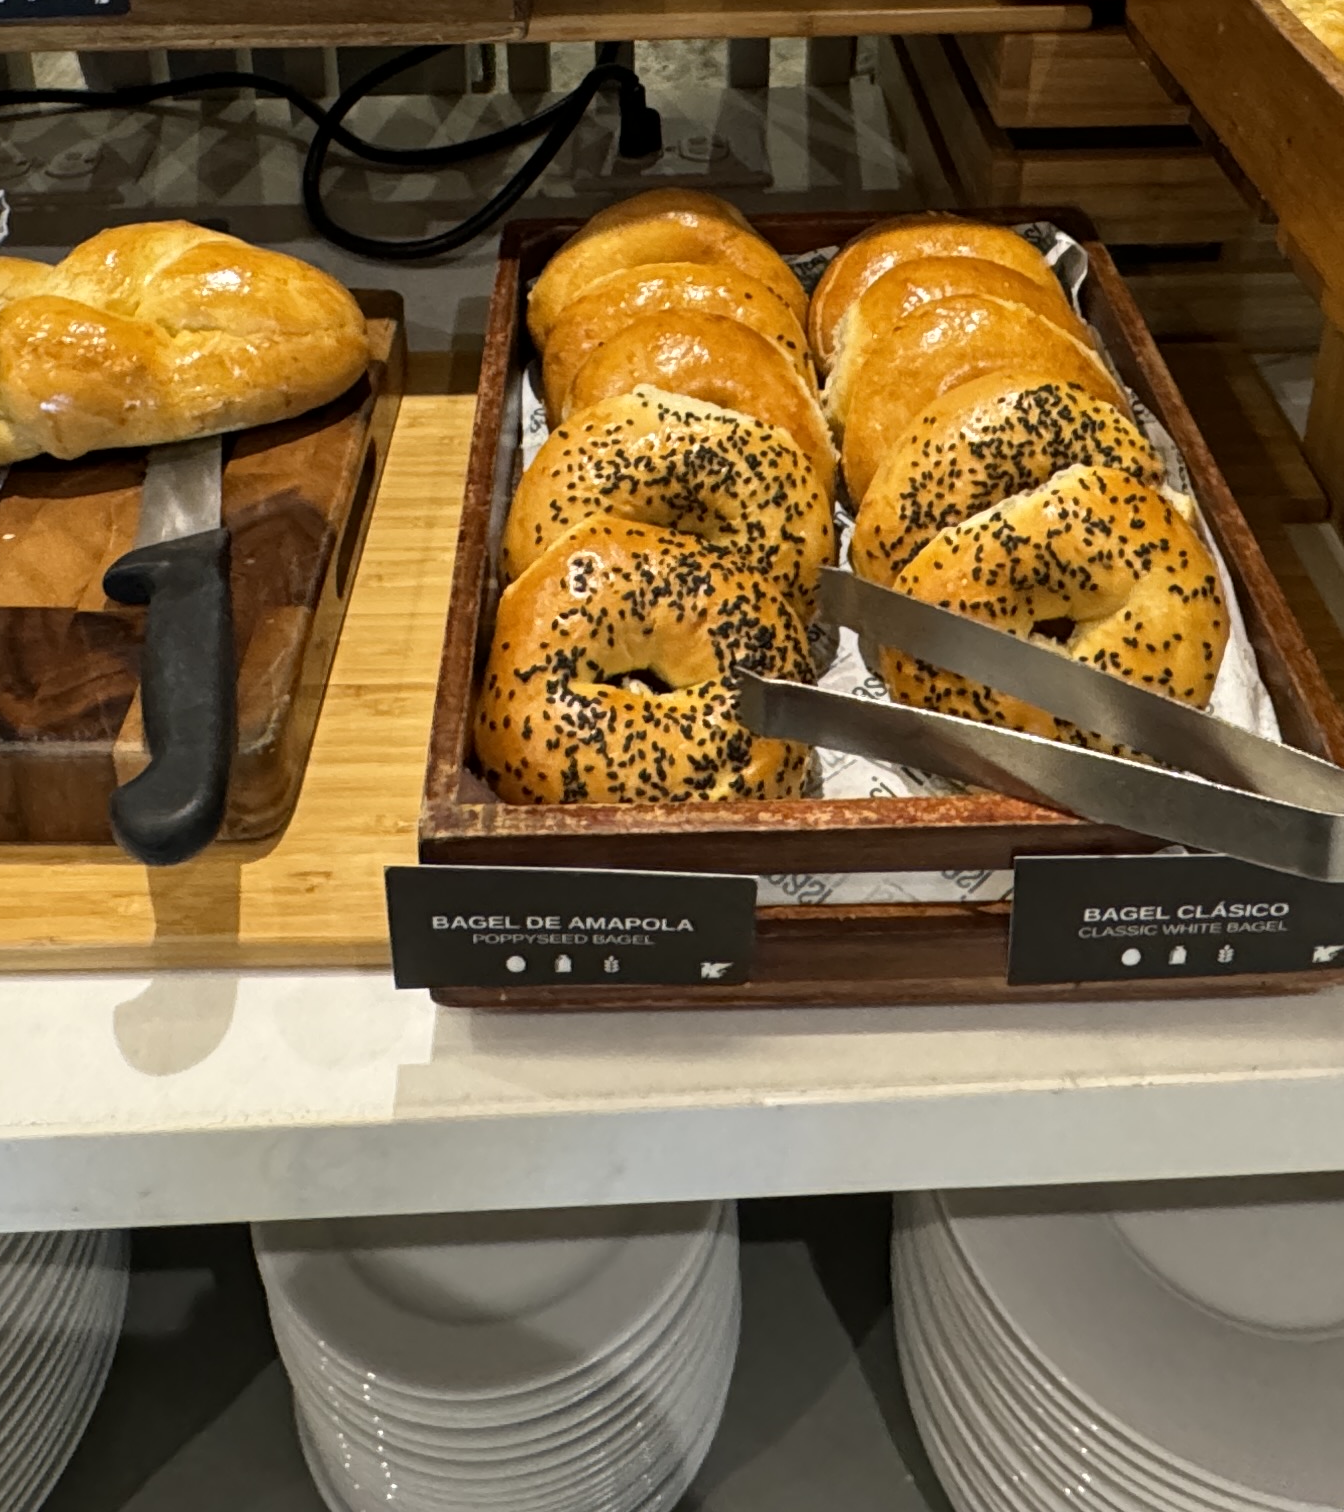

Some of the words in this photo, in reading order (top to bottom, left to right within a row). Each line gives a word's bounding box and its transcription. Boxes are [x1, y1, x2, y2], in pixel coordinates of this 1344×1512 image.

[1083, 906, 1170, 922] BAGEL
[1177, 900, 1290, 920] CLÁSICO
[432, 915, 520, 930] BAGEL
[526, 915, 561, 930] DE
[568, 916, 694, 932] AMAPOLA
[1078, 923, 1158, 938] CLASSIC
[1162, 921, 1222, 936] WHITE
[1226, 919, 1289, 934] BAGEL
[472, 933, 588, 945] POPPYSEED
[591, 934, 655, 946] BAGEL
